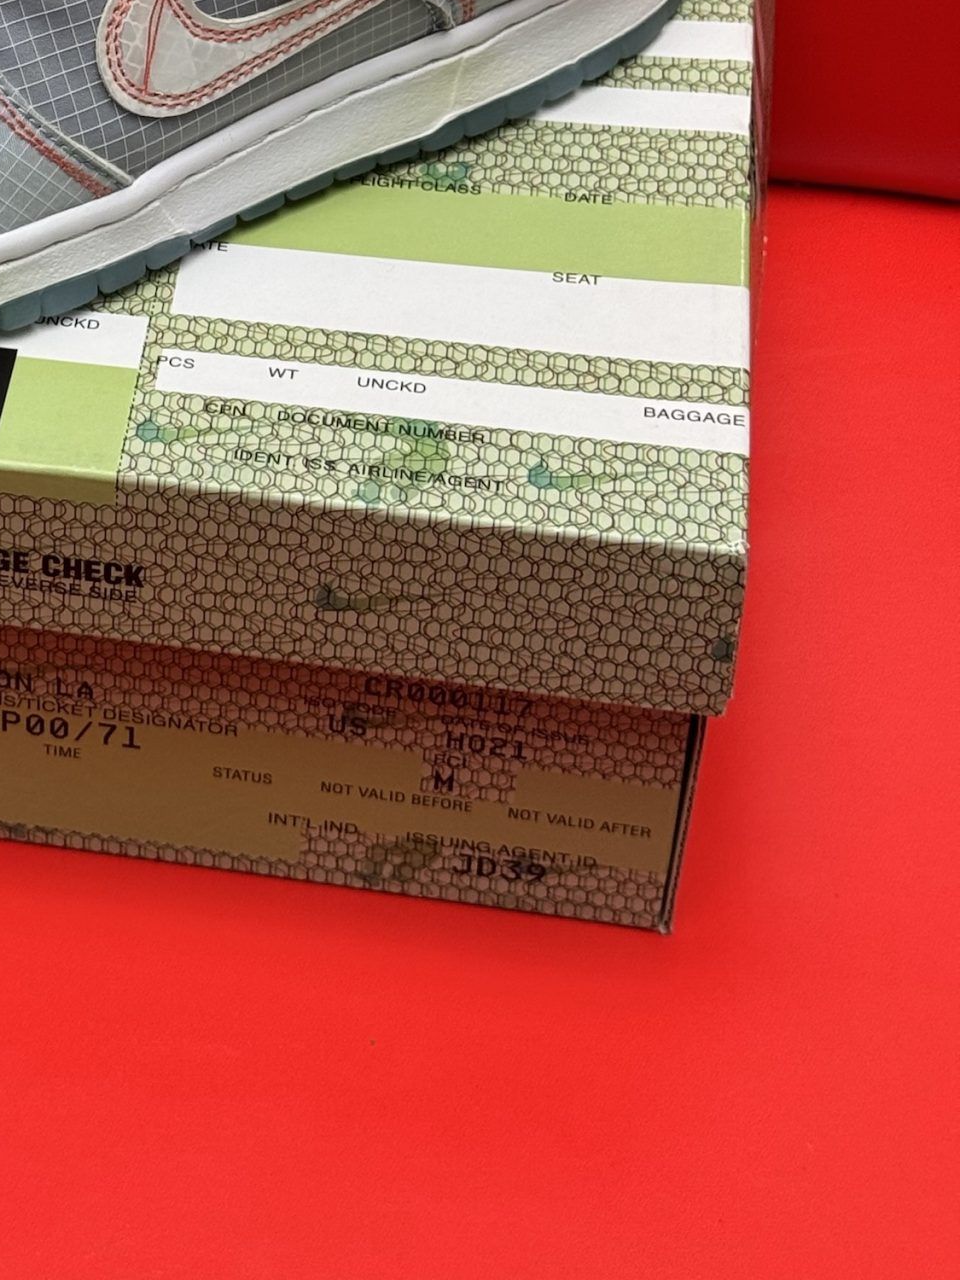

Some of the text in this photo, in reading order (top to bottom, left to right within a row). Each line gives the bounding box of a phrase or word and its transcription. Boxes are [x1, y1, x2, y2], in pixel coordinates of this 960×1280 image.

[421, 180, 482, 195] CLASS
[563, 190, 614, 206] DATE
[552, 270, 603, 287] SEAT
[157, 354, 746, 427] PCS WT UNCKD BAGGAGE
[204, 402, 487, 445] CPN DOCUMENT NUMBER
[234, 448, 292, 469] IDENT
[348, 464, 505, 493] AIRLINE/AGENT
[40, 553, 146, 588] CHECK
[88, 587, 138, 604] SIDE
[55, 676, 95, 699] LA
[102, 705, 239, 738] DESIGNATOR
[329, 714, 368, 736] US
[43, 743, 82, 760] TIME
[212, 765, 274, 786] STATUS
[433, 770, 455, 792] M
[319, 780, 474, 814] NOT VALID BEFORE
[324, 820, 359, 835] IND
[507, 806, 653, 839] NOT VALID AFTER
[406, 831, 598, 867] ISSUING AGENT ID
[451, 853, 548, 885] JD39
